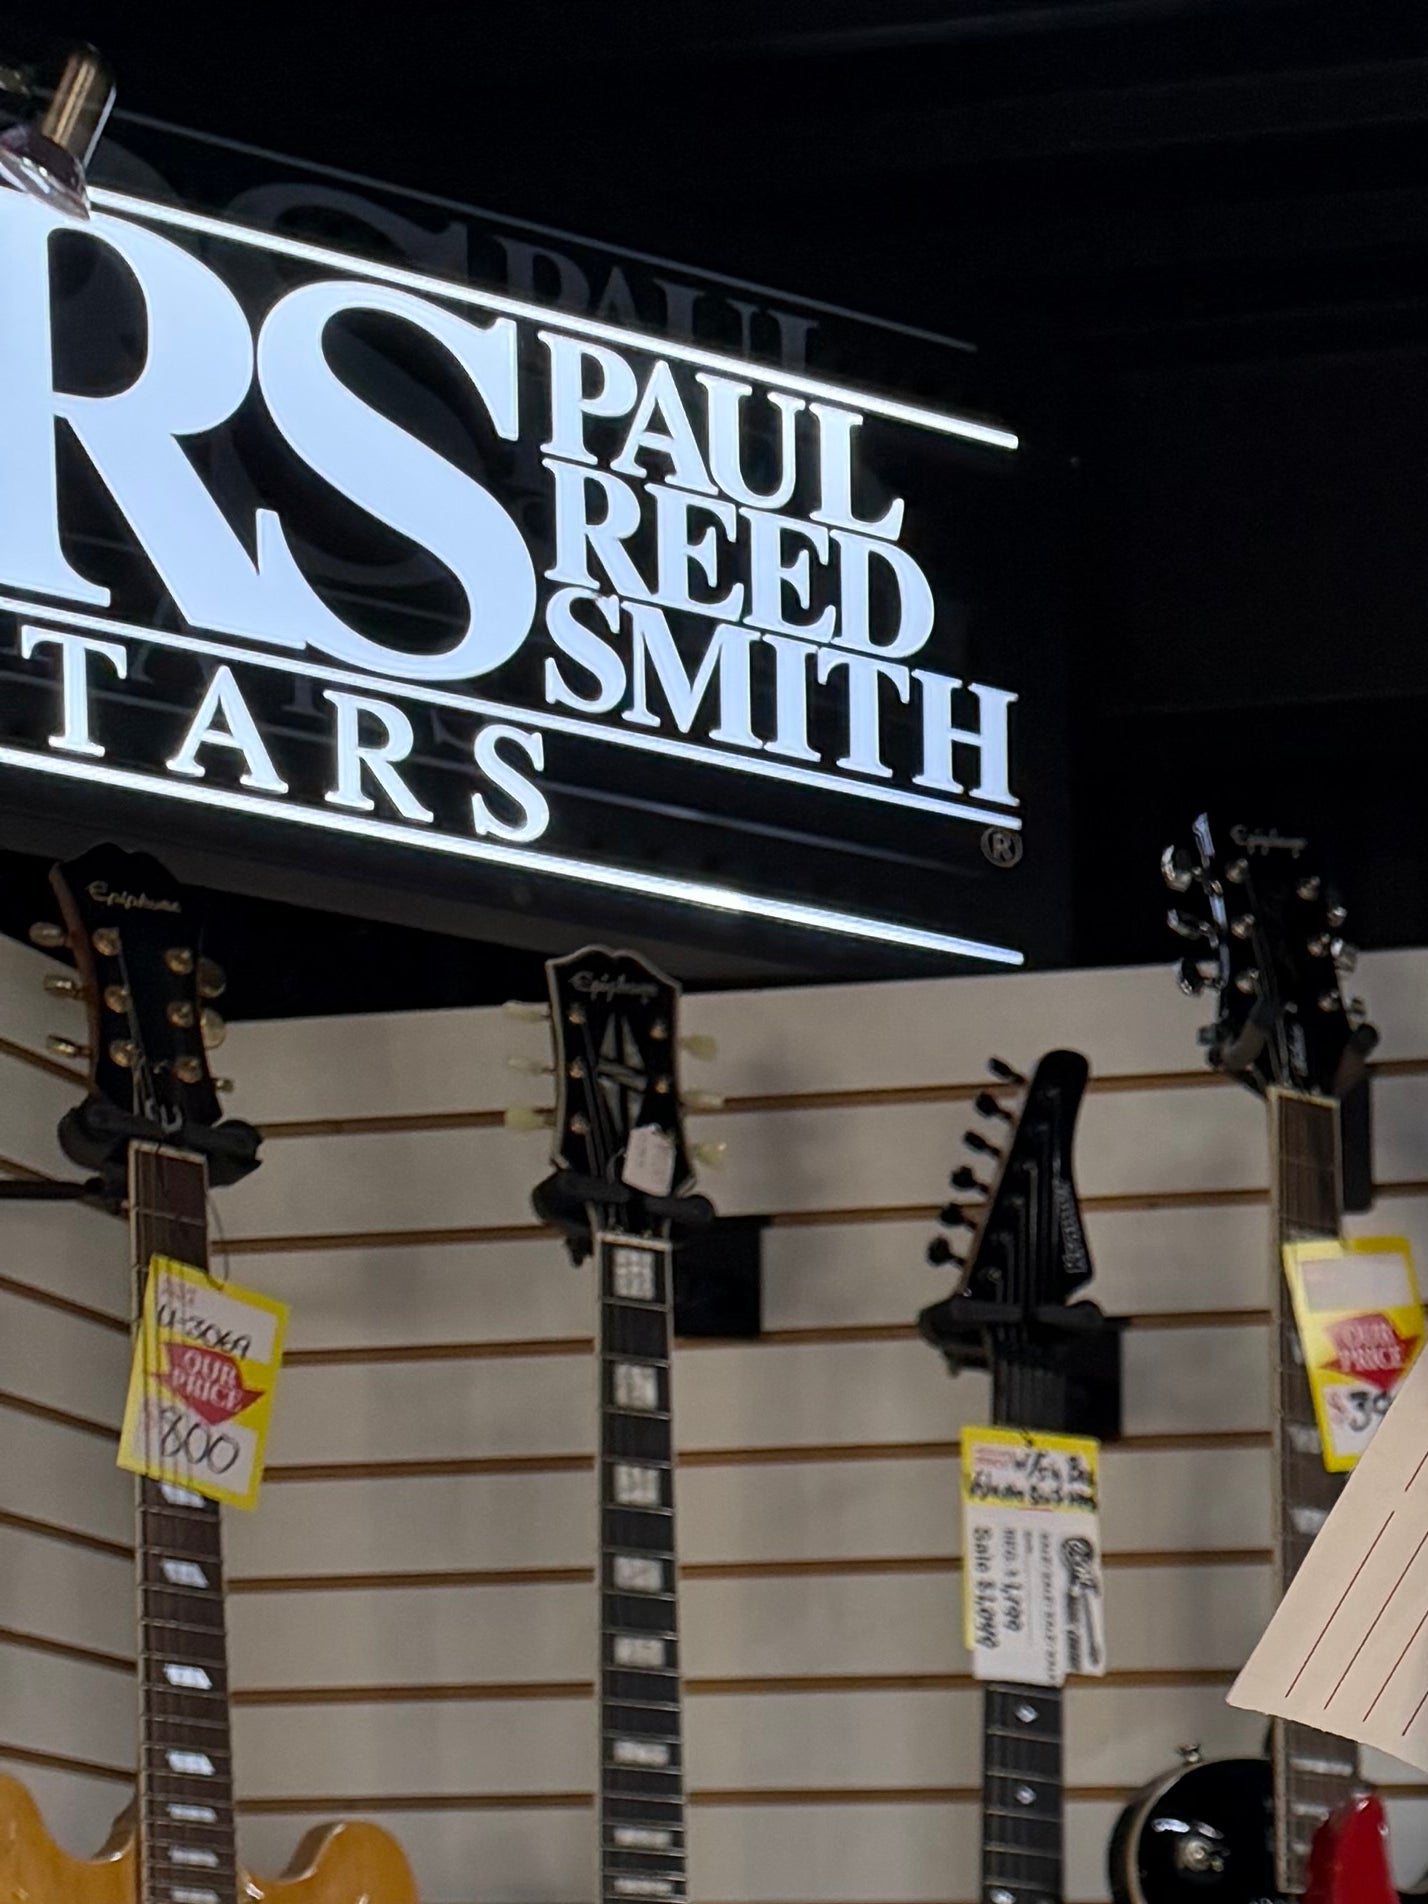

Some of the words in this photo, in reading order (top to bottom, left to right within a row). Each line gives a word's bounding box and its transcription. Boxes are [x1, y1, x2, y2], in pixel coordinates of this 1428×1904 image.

[538, 330, 905, 542] PAUL
[543, 459, 936, 659] REED
[545, 586, 1019, 808] SMITH
[171, 1367, 242, 1413] PRICE
[184, 1350, 237, 1386] OUR
